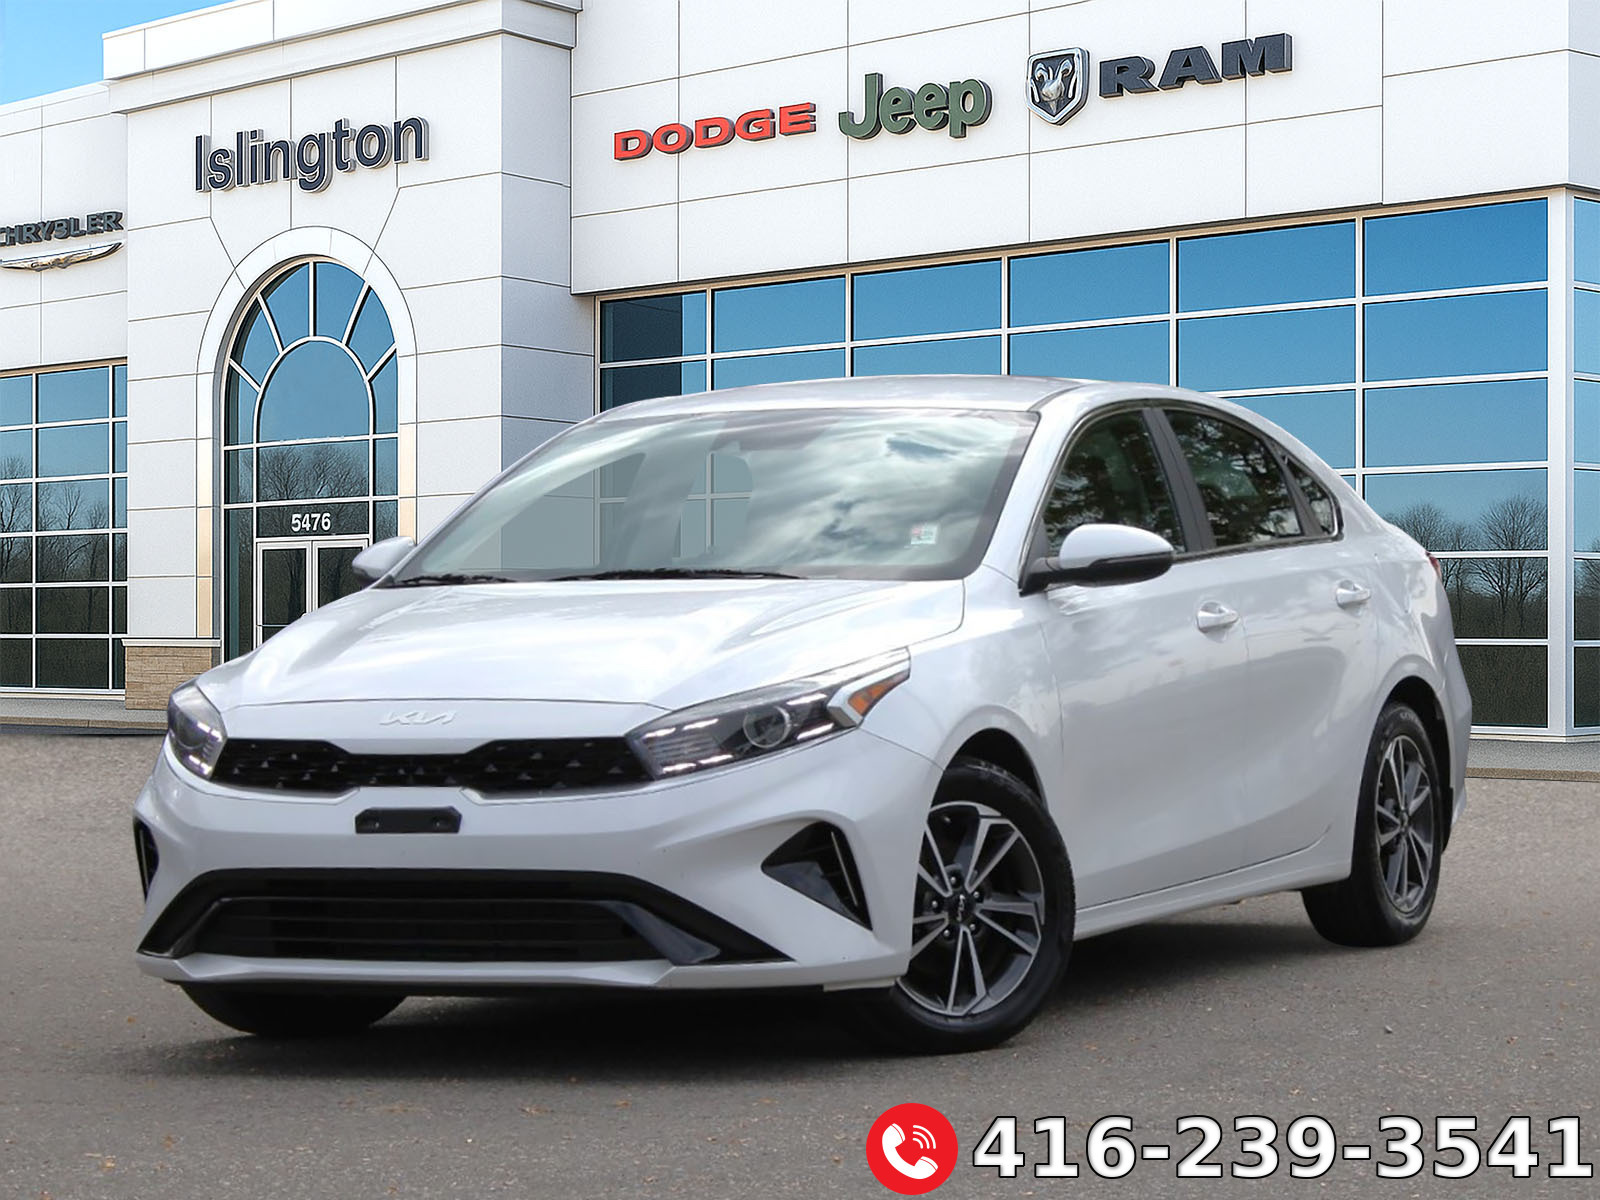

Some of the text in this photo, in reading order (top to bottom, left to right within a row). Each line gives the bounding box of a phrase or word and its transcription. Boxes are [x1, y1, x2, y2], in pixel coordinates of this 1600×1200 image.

[613, 33, 1293, 160] DODGE Jeep RAM
[195, 117, 429, 192] Islington
[291, 512, 331, 532] 5476
